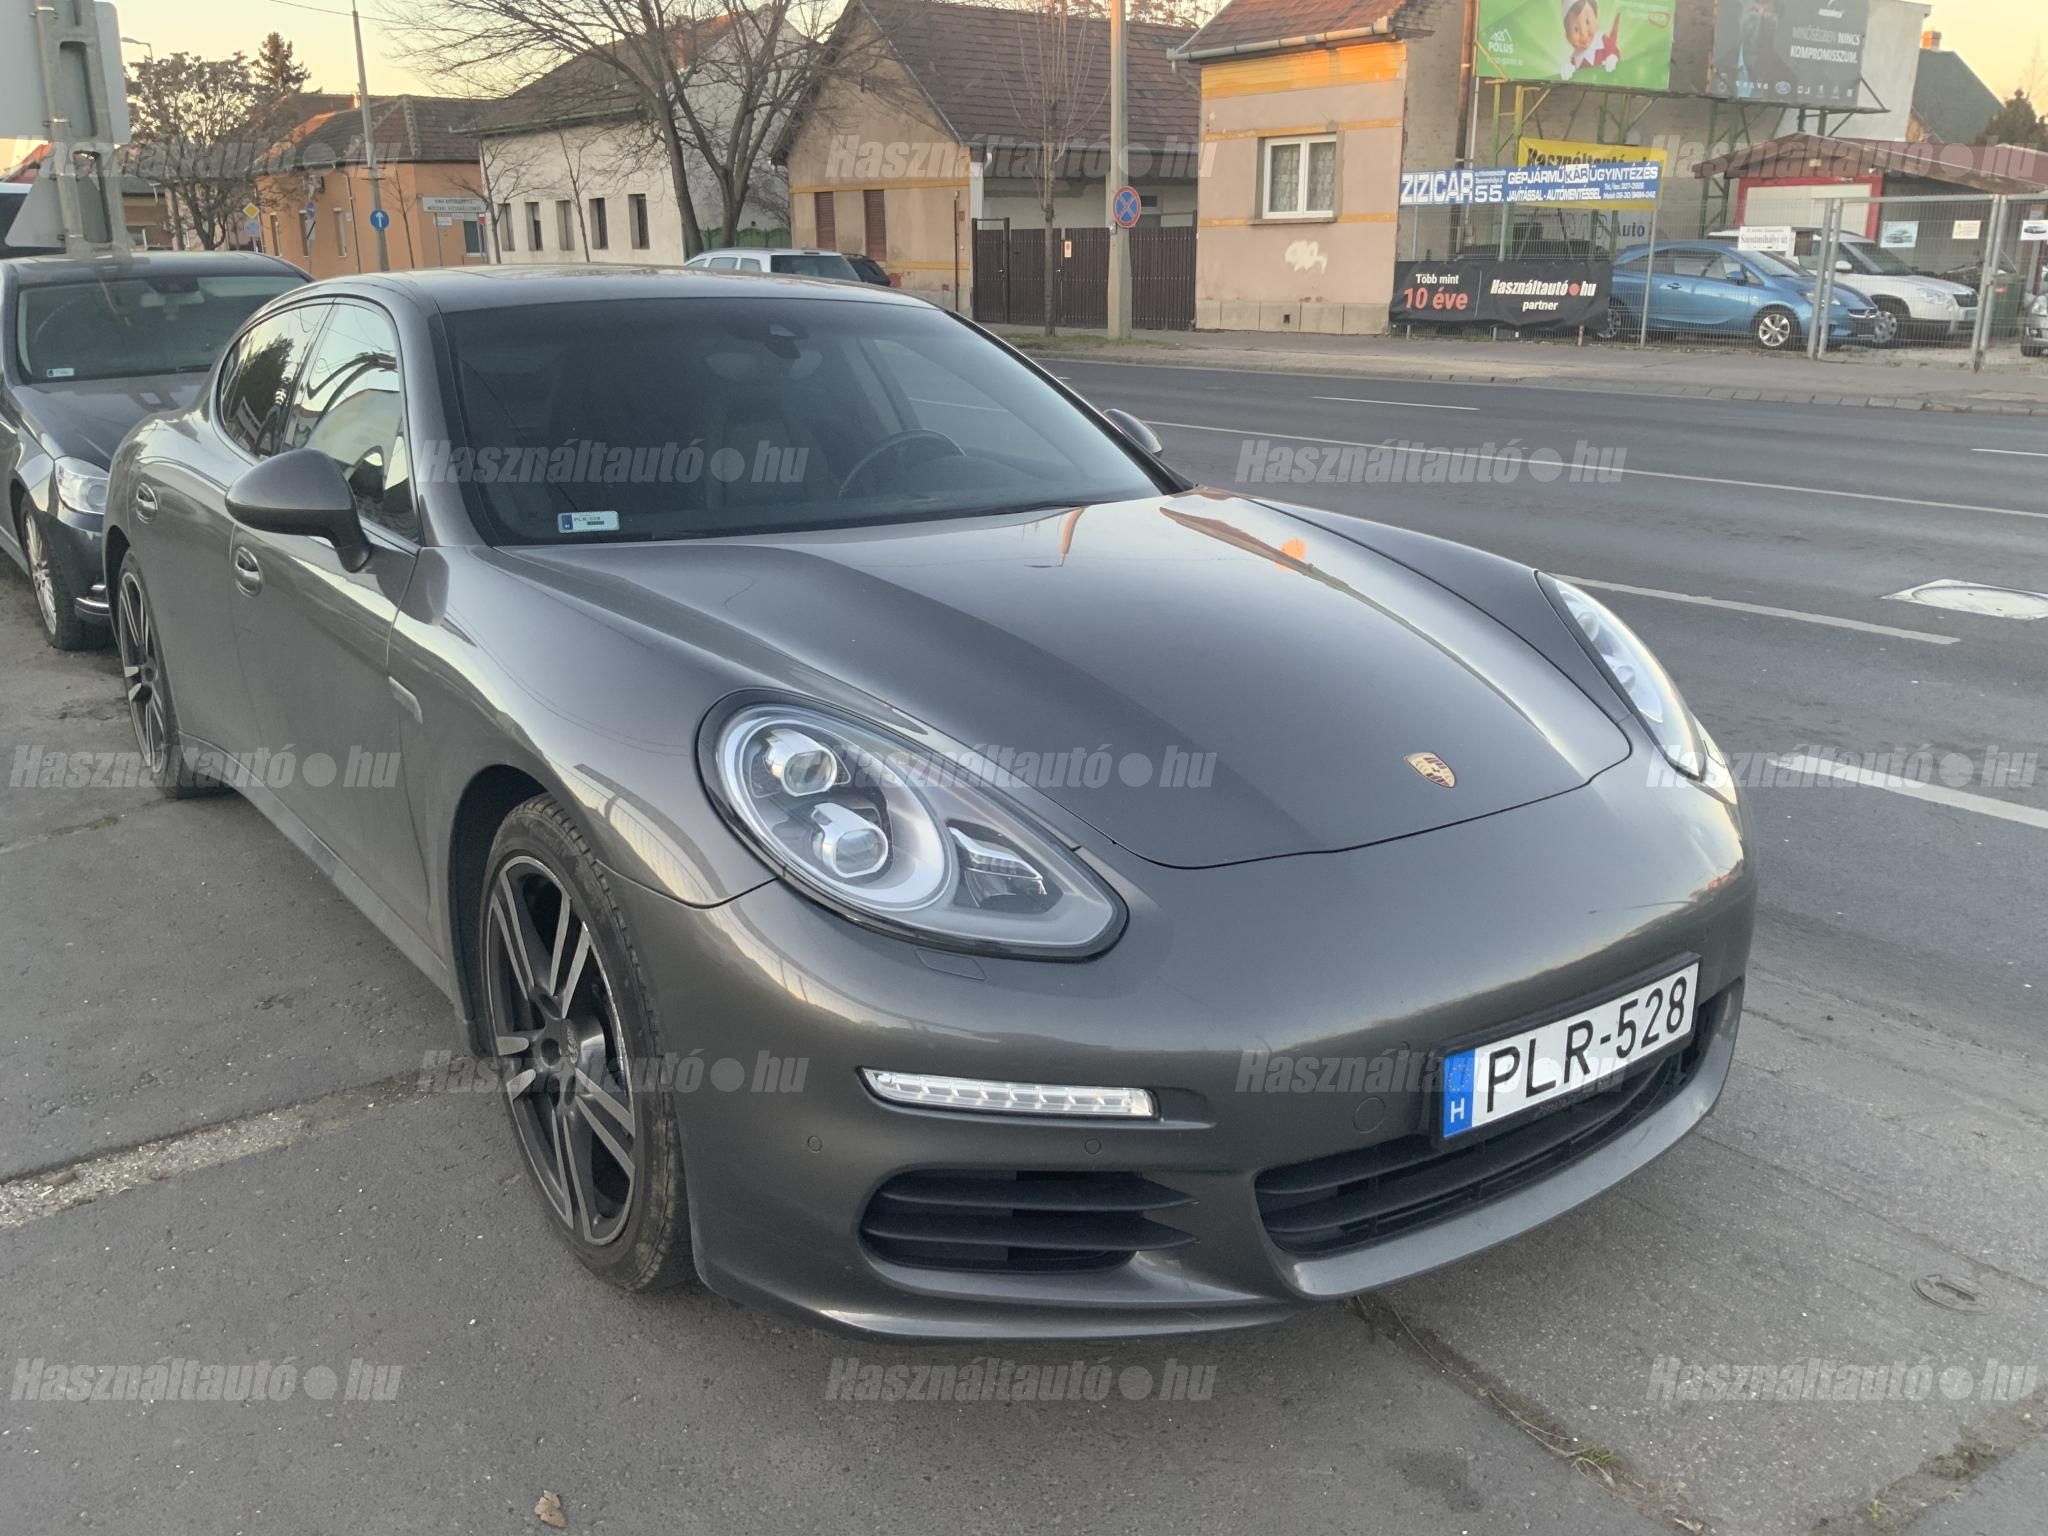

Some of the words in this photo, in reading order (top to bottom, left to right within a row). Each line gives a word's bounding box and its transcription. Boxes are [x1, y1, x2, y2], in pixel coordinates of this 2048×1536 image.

[1400, 170, 1474, 204] ZIZICAR
[1416, 273, 1438, 284] Több
[1439, 274, 1459, 285] mint
[1403, 287, 1429, 309] 10
[1432, 287, 1468, 310] éve
[1522, 300, 1559, 312] partner
[1486, 976, 1688, 1113] PLR-528
[1450, 1097, 1465, 1123] H
